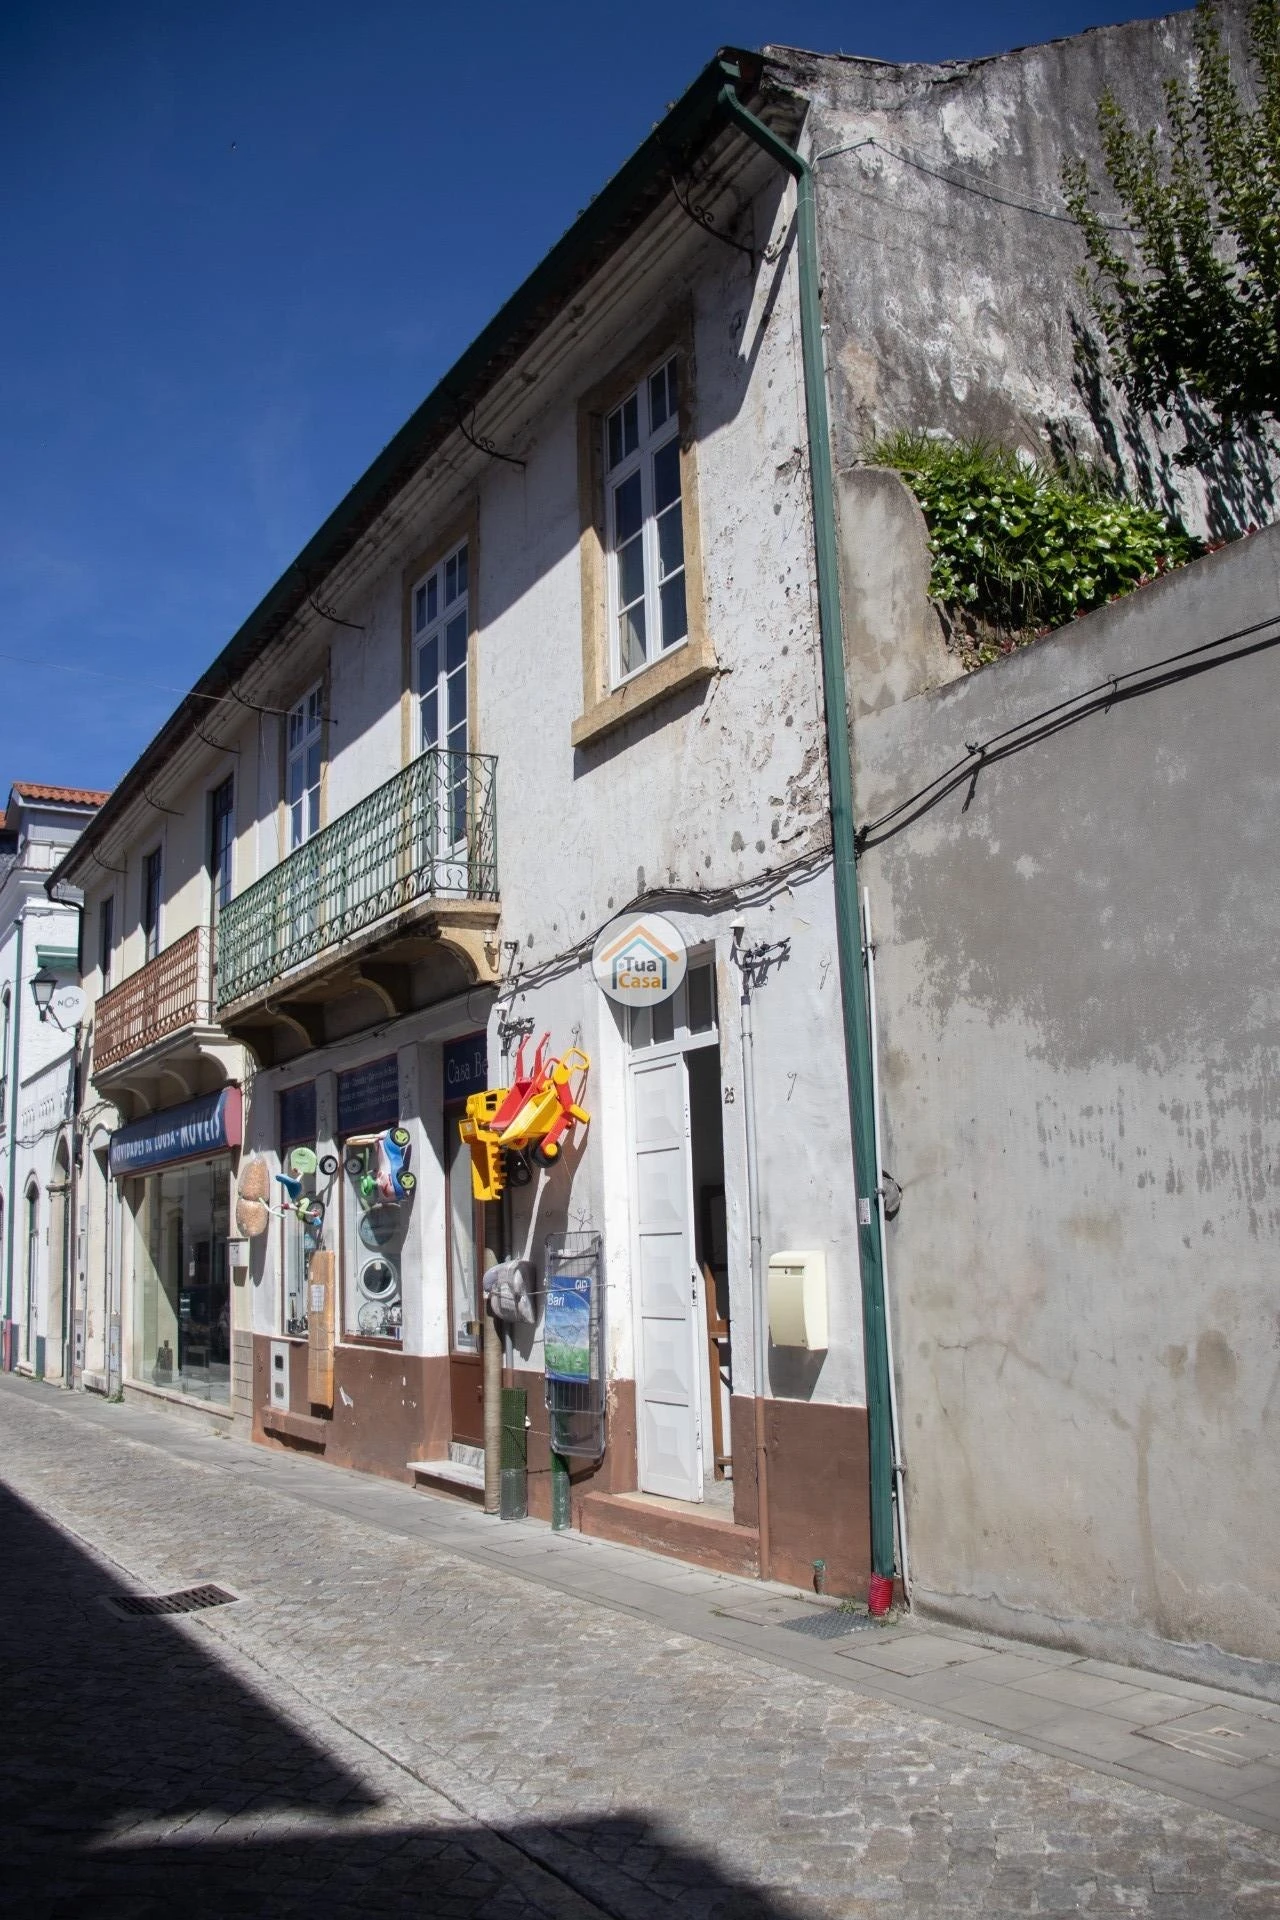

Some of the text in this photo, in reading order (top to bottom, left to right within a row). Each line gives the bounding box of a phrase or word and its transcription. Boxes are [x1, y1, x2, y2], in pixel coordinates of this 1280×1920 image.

[57, 996, 80, 1008] NOS
[447, 1058, 470, 1084] Casa
[547, 1292, 565, 1307] Bari
